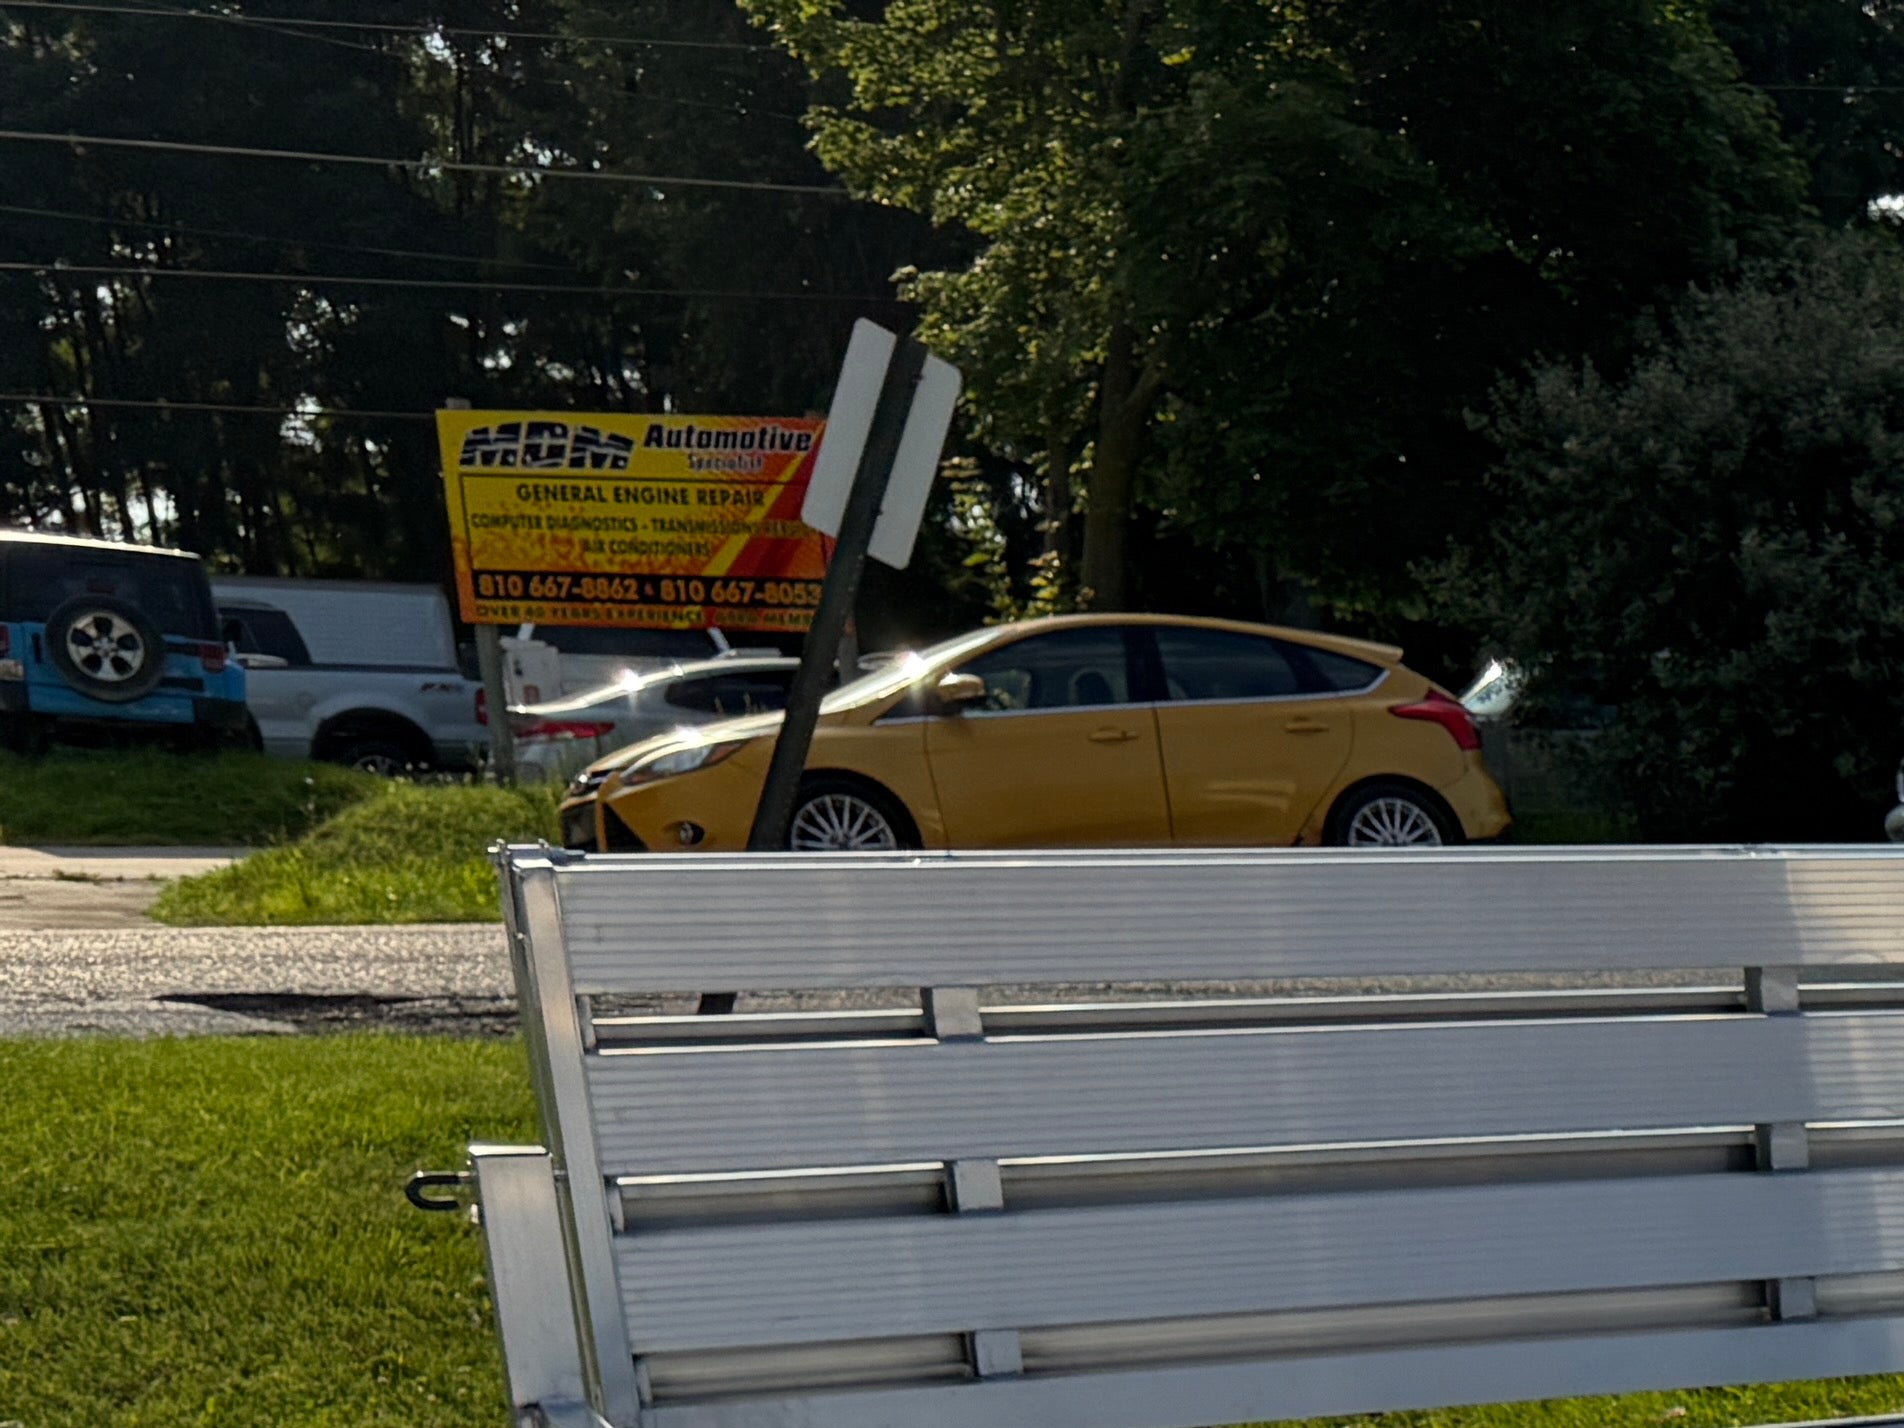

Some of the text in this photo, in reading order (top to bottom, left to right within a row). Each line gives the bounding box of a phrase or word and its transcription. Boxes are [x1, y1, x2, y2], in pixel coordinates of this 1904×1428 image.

[643, 423, 812, 451] Automotive
[516, 484, 765, 506] GENERAL ENGINE REPAIR
[478, 574, 523, 597] 810
[529, 575, 639, 600] 667-8862
[661, 579, 704, 598] 810
